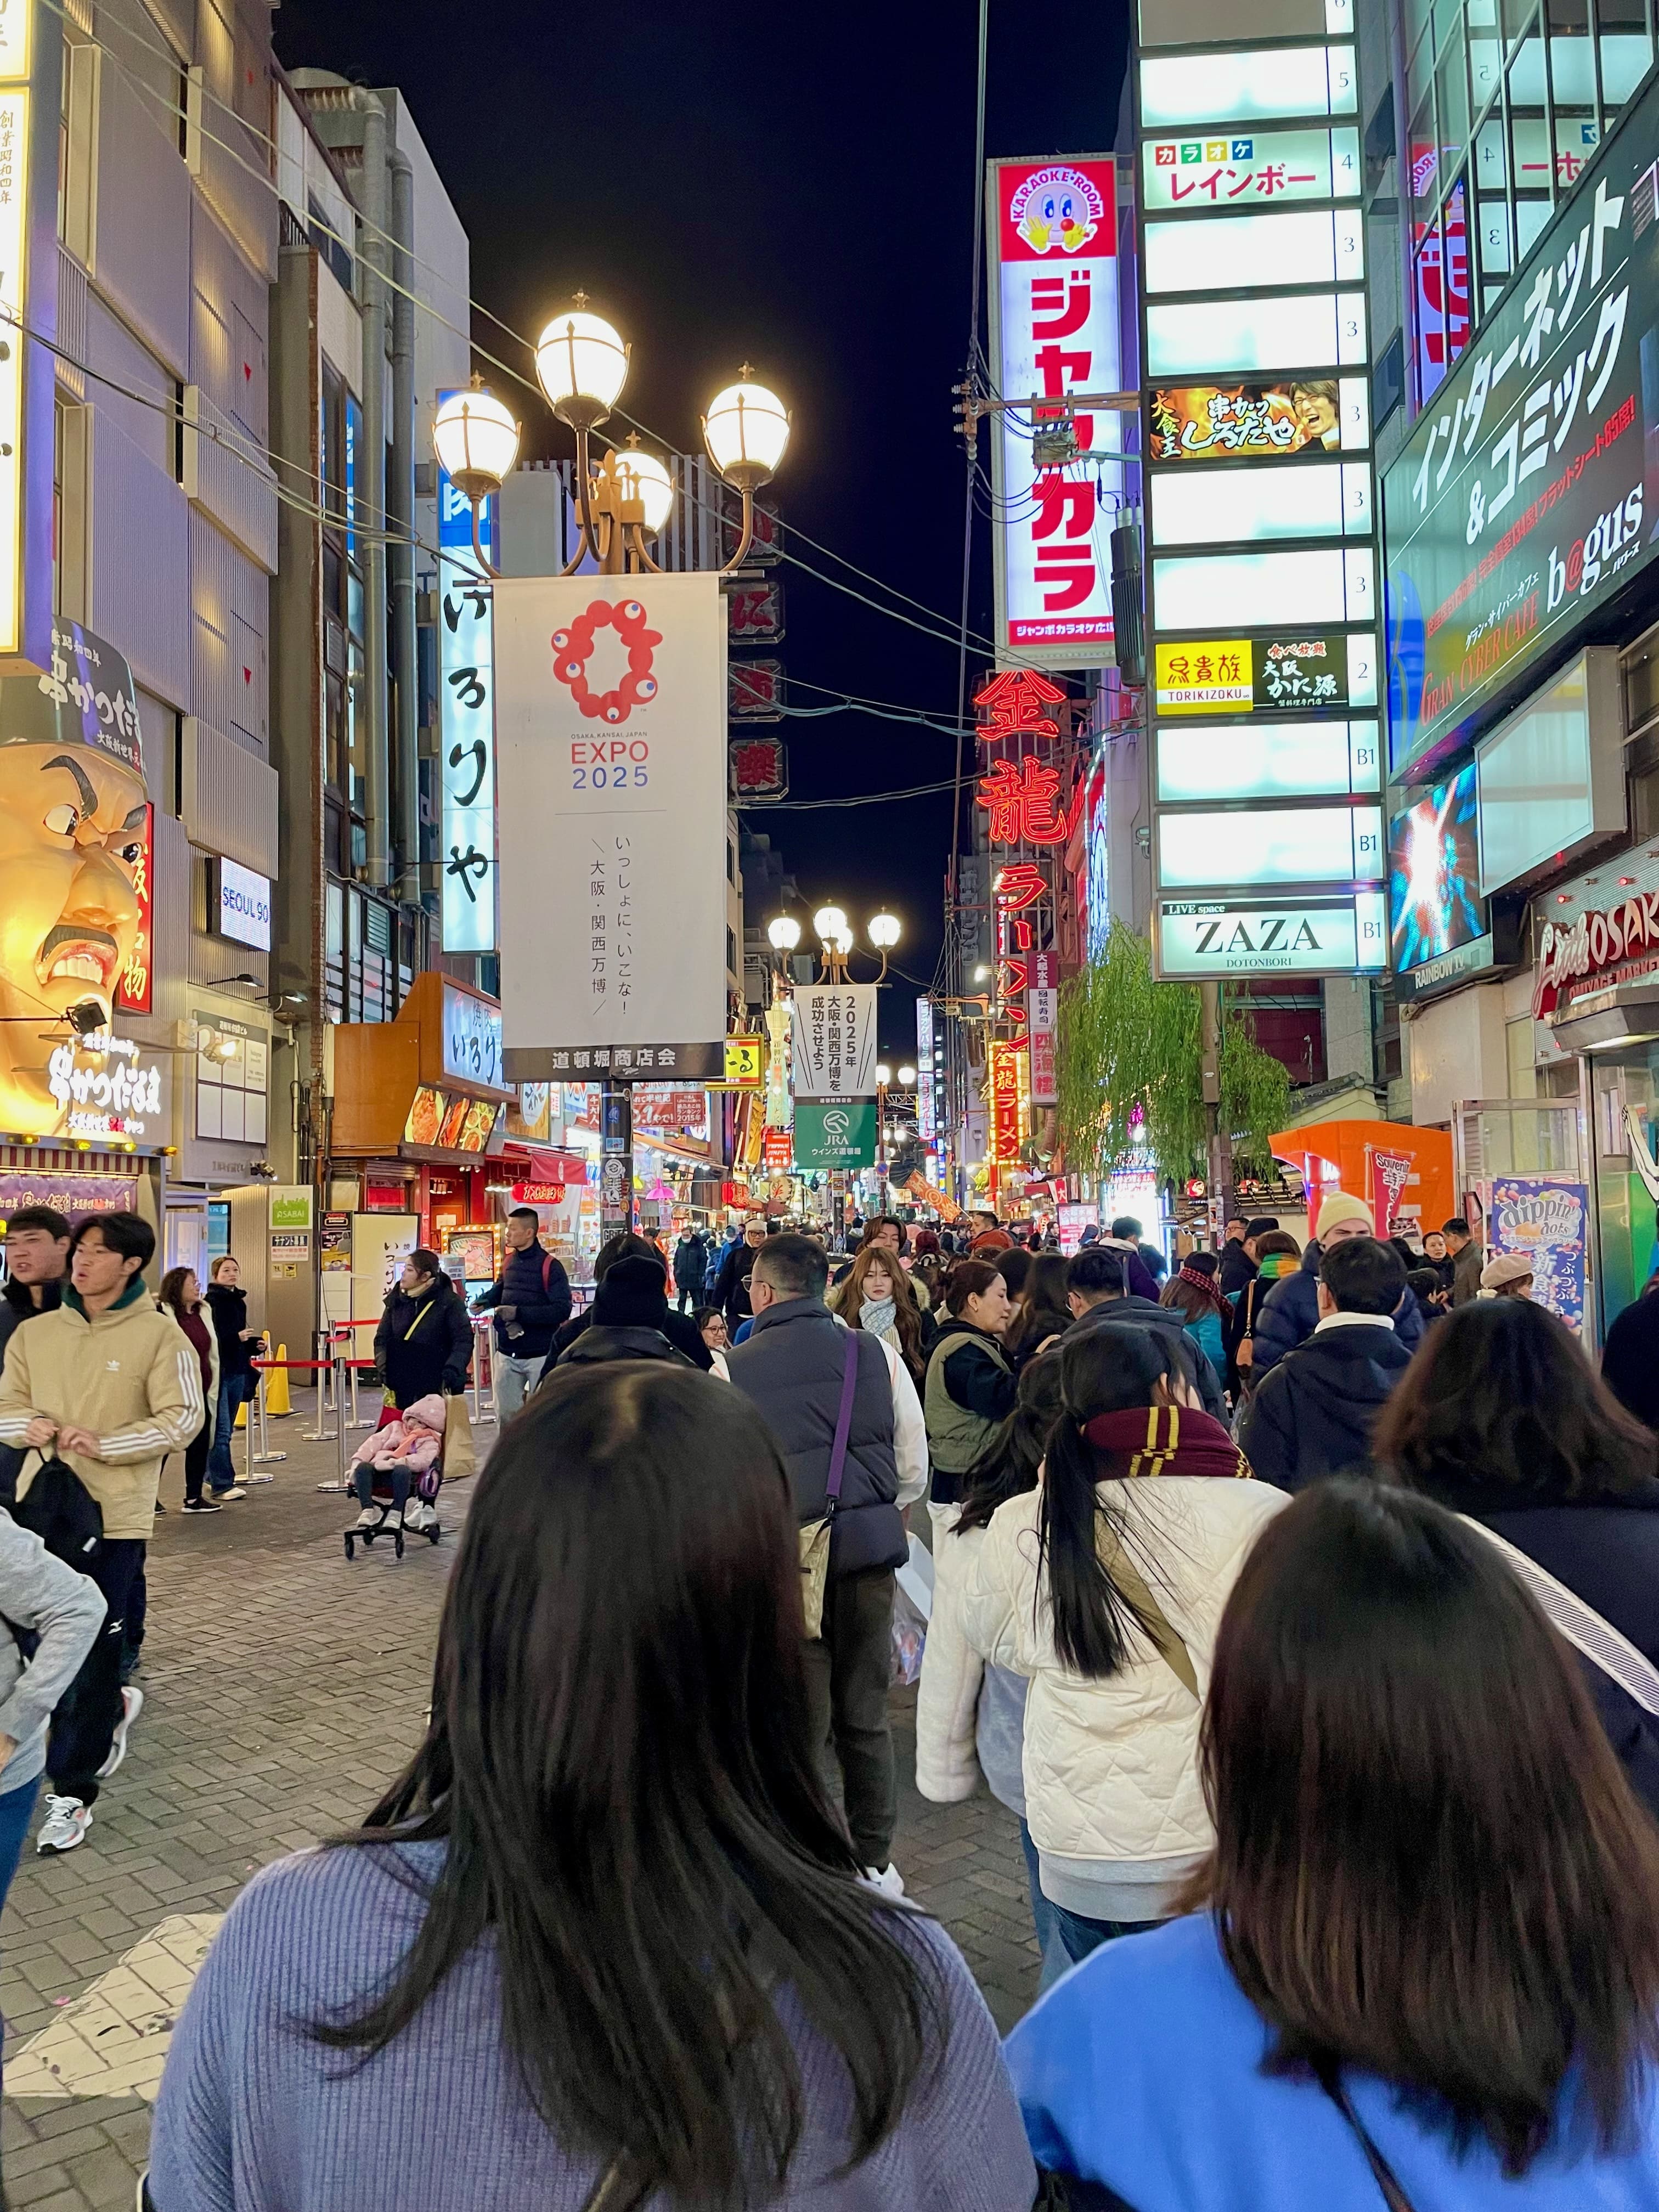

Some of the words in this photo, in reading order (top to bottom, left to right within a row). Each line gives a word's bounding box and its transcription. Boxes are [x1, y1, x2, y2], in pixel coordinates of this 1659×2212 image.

[1339, 72, 1349, 88] 5
[1158, 142, 1251, 163] カラオケ
[1341, 154, 1353, 170] 4
[1170, 163, 1316, 201] レインボー
[1344, 236, 1355, 253] 3
[1347, 321, 1358, 337] 3
[1412, 176, 1625, 514] インターネット
[1208, 393, 1271, 420] 串かつ
[1350, 405, 1361, 422] 3
[1353, 490, 1364, 507] 3
[1356, 577, 1366, 594] 3
[1268, 641, 1327, 659] 食べ放題
[1460, 627, 1502, 692] CYBER
[1167, 654, 1242, 685] 鳥貴族
[1261, 660, 1304, 678] 大阪
[1358, 663, 1368, 679] 2
[1167, 688, 1242, 702] TORIKIZOKU
[1267, 675, 1339, 699] かに源
[571, 740, 649, 764] EXPO
[1357, 748, 1375, 765] B1
[572, 766, 648, 789] 2025
[1359, 834, 1377, 851] B1
[223, 886, 256, 918] SEOUL
[257, 901, 269, 923] 90
[1169, 905, 1195, 915] LIVE
[1198, 904, 1225, 915] space
[590, 860, 606, 994] 大阪・関西万博
[1194, 918, 1323, 953] ZAZA
[1363, 922, 1381, 939] B1
[1226, 957, 1293, 968] DOTONBORI
[1415, 956, 1453, 990] RAINBOW
[1454, 952, 1465, 969] TV
[811, 996, 825, 1070] 成功させよう
[845, 996, 856, 1067] 2025年
[827, 996, 841, 1092] 大阪・関西万博を
[453, 1034, 505, 1087] いろり
[552, 1048, 676, 1069] 道頓堀商店会
[994, 1051, 1018, 1160] 金龍ラーメン
[823, 1135, 849, 1146] JRA
[1541, 1222, 1570, 1236] dots
